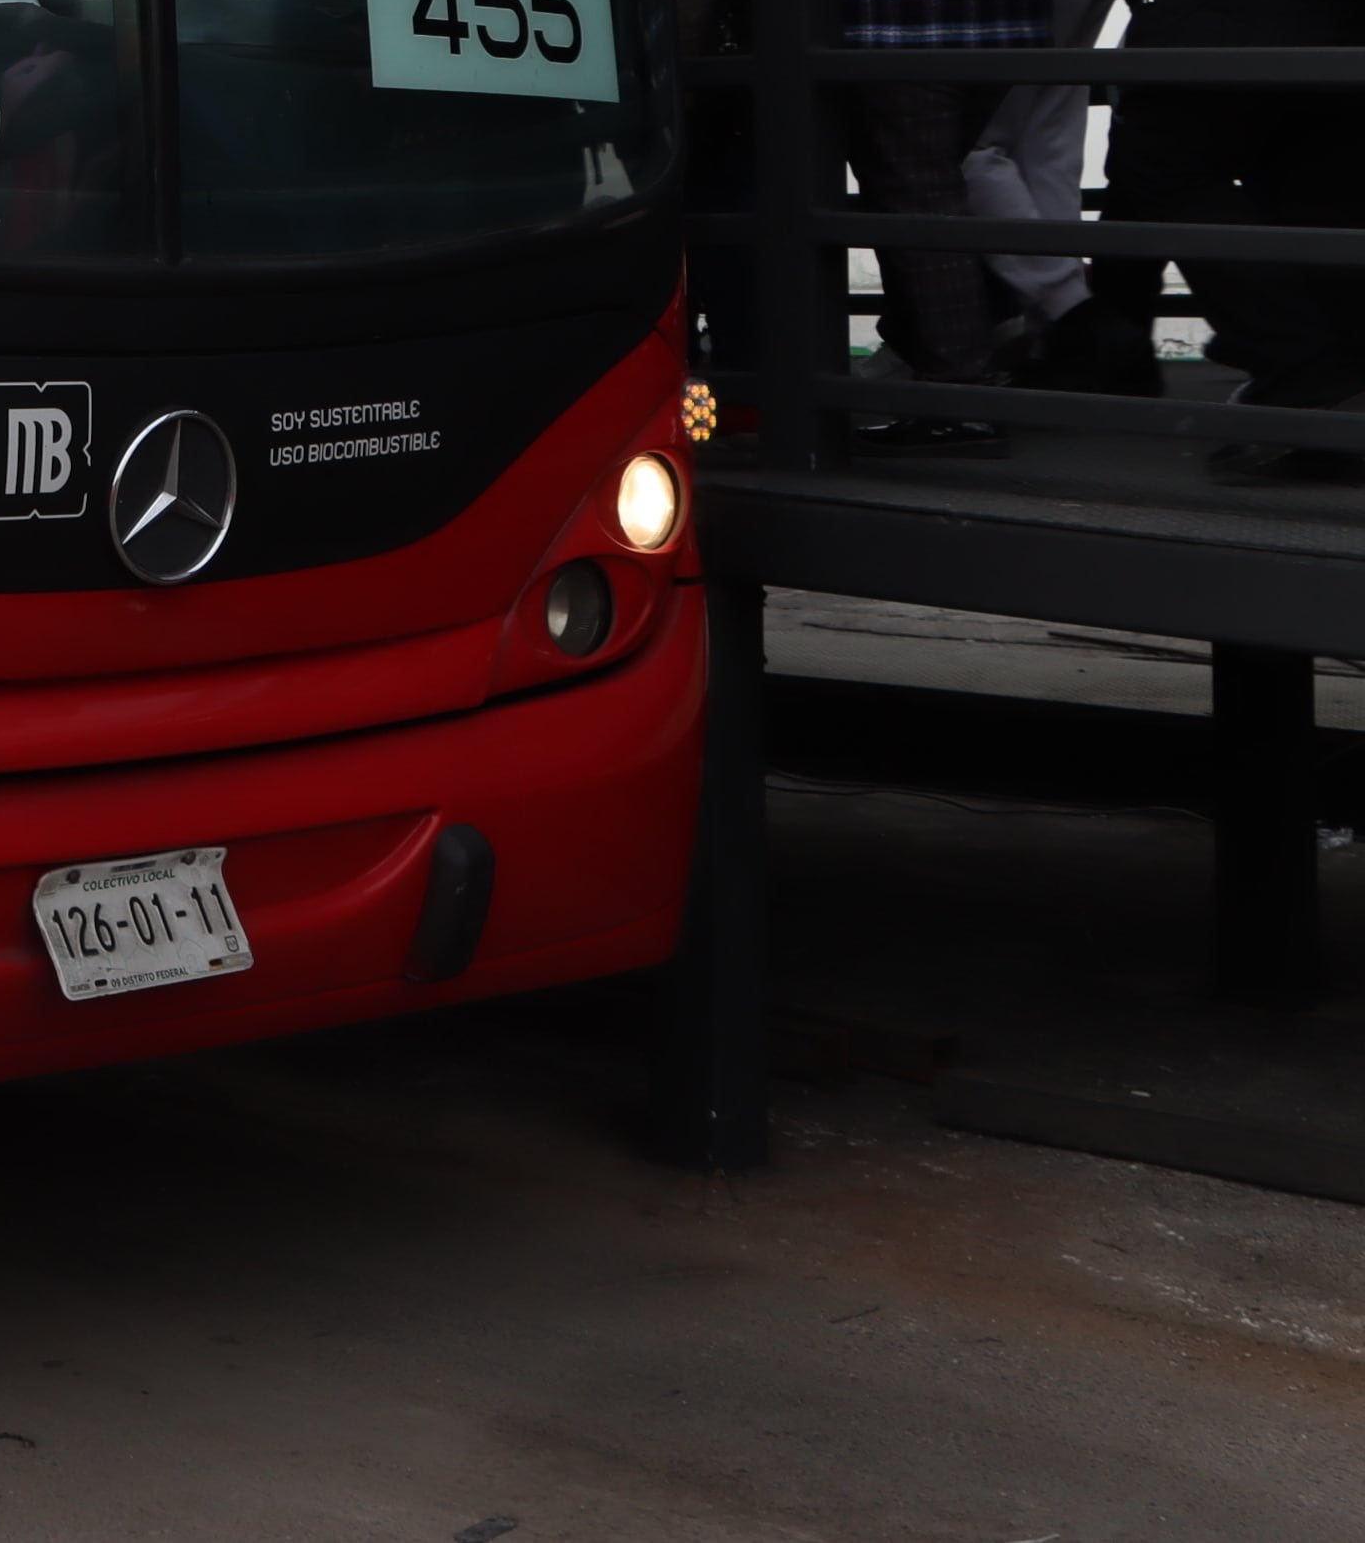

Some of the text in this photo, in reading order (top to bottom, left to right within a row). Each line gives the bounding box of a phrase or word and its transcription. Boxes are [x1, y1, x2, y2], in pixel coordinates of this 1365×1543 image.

[271, 399, 421, 433] SOY SUSTENTABLE
[270, 431, 442, 467] USO BIOCOMBUSTIBLE
[82, 868, 176, 892] COLECTIVO LOCAL
[51, 883, 233, 960] 126-01-11
[111, 967, 189, 988] 09 DISTRITO FEDERAL
